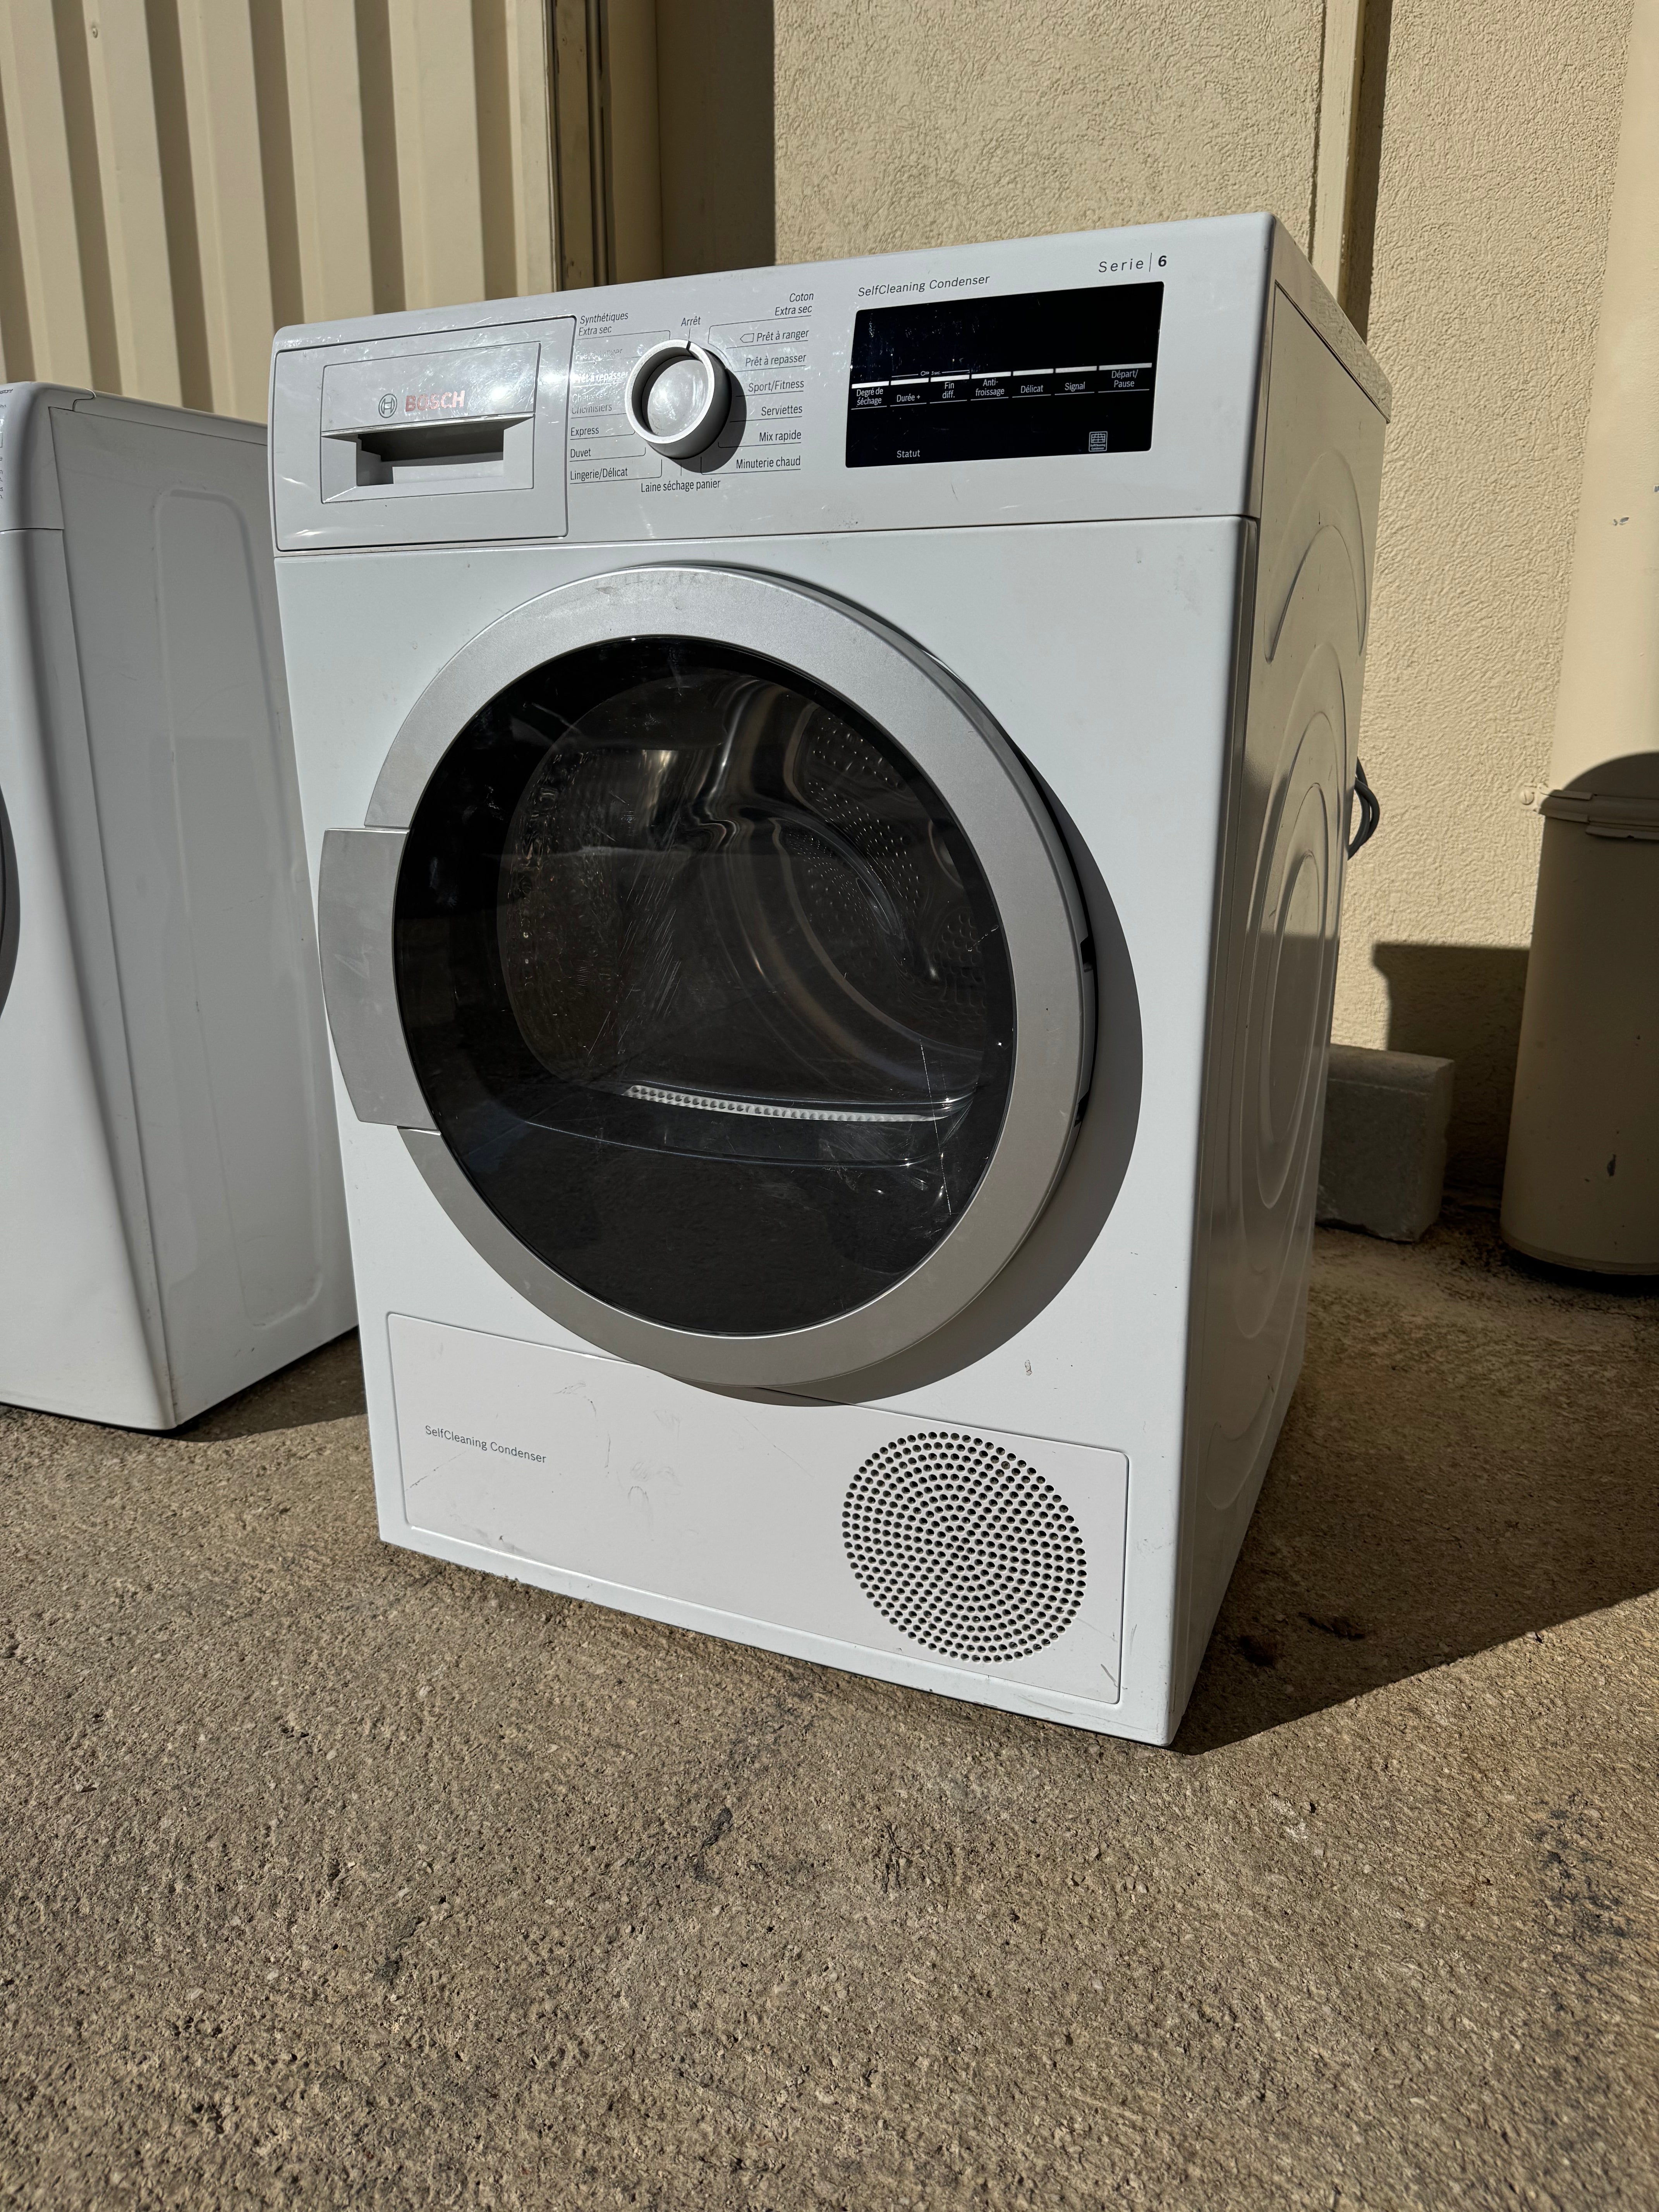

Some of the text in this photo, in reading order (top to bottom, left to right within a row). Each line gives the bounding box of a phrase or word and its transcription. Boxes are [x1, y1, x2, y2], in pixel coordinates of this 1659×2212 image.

[1098, 256, 1167, 273] Serie 6
[858, 275, 990, 297] SelfCleaning Condenser
[790, 293, 814, 302] Coton
[775, 306, 795, 316] Extra
[580, 313, 629, 326] Synthétiques
[681, 316, 701, 326] Arrêt
[579, 326, 612, 336] Extra sec
[757, 330, 809, 342] Prêt à ranger
[745, 354, 806, 367] Prêt à repasser
[1111, 369, 1138, 379] Départ/
[748, 380, 804, 393] Sport/Fitness
[857, 387, 874, 397] Degré
[975, 387, 1005, 397] froissage
[1020, 384, 1043, 393] Délicat
[1065, 381, 1085, 392] Signal
[896, 393, 915, 402] Durée
[942, 391, 955, 399] diff.
[405, 390, 465, 412] BOSCH
[857, 397, 882, 406] séchage
[761, 405, 802, 416] Serviettes
[570, 426, 599, 438] Express
[759, 429, 801, 442] Mix rapide
[570, 448, 591, 458] Duvet
[896, 449, 920, 458] Statut
[737, 455, 800, 469] Minuterie chaud
[570, 467, 628, 481] Lingerie/Délicat
[641, 479, 721, 493] Laine séchage panier
[425, 1425, 546, 1463] SelfCleaning Condenser
